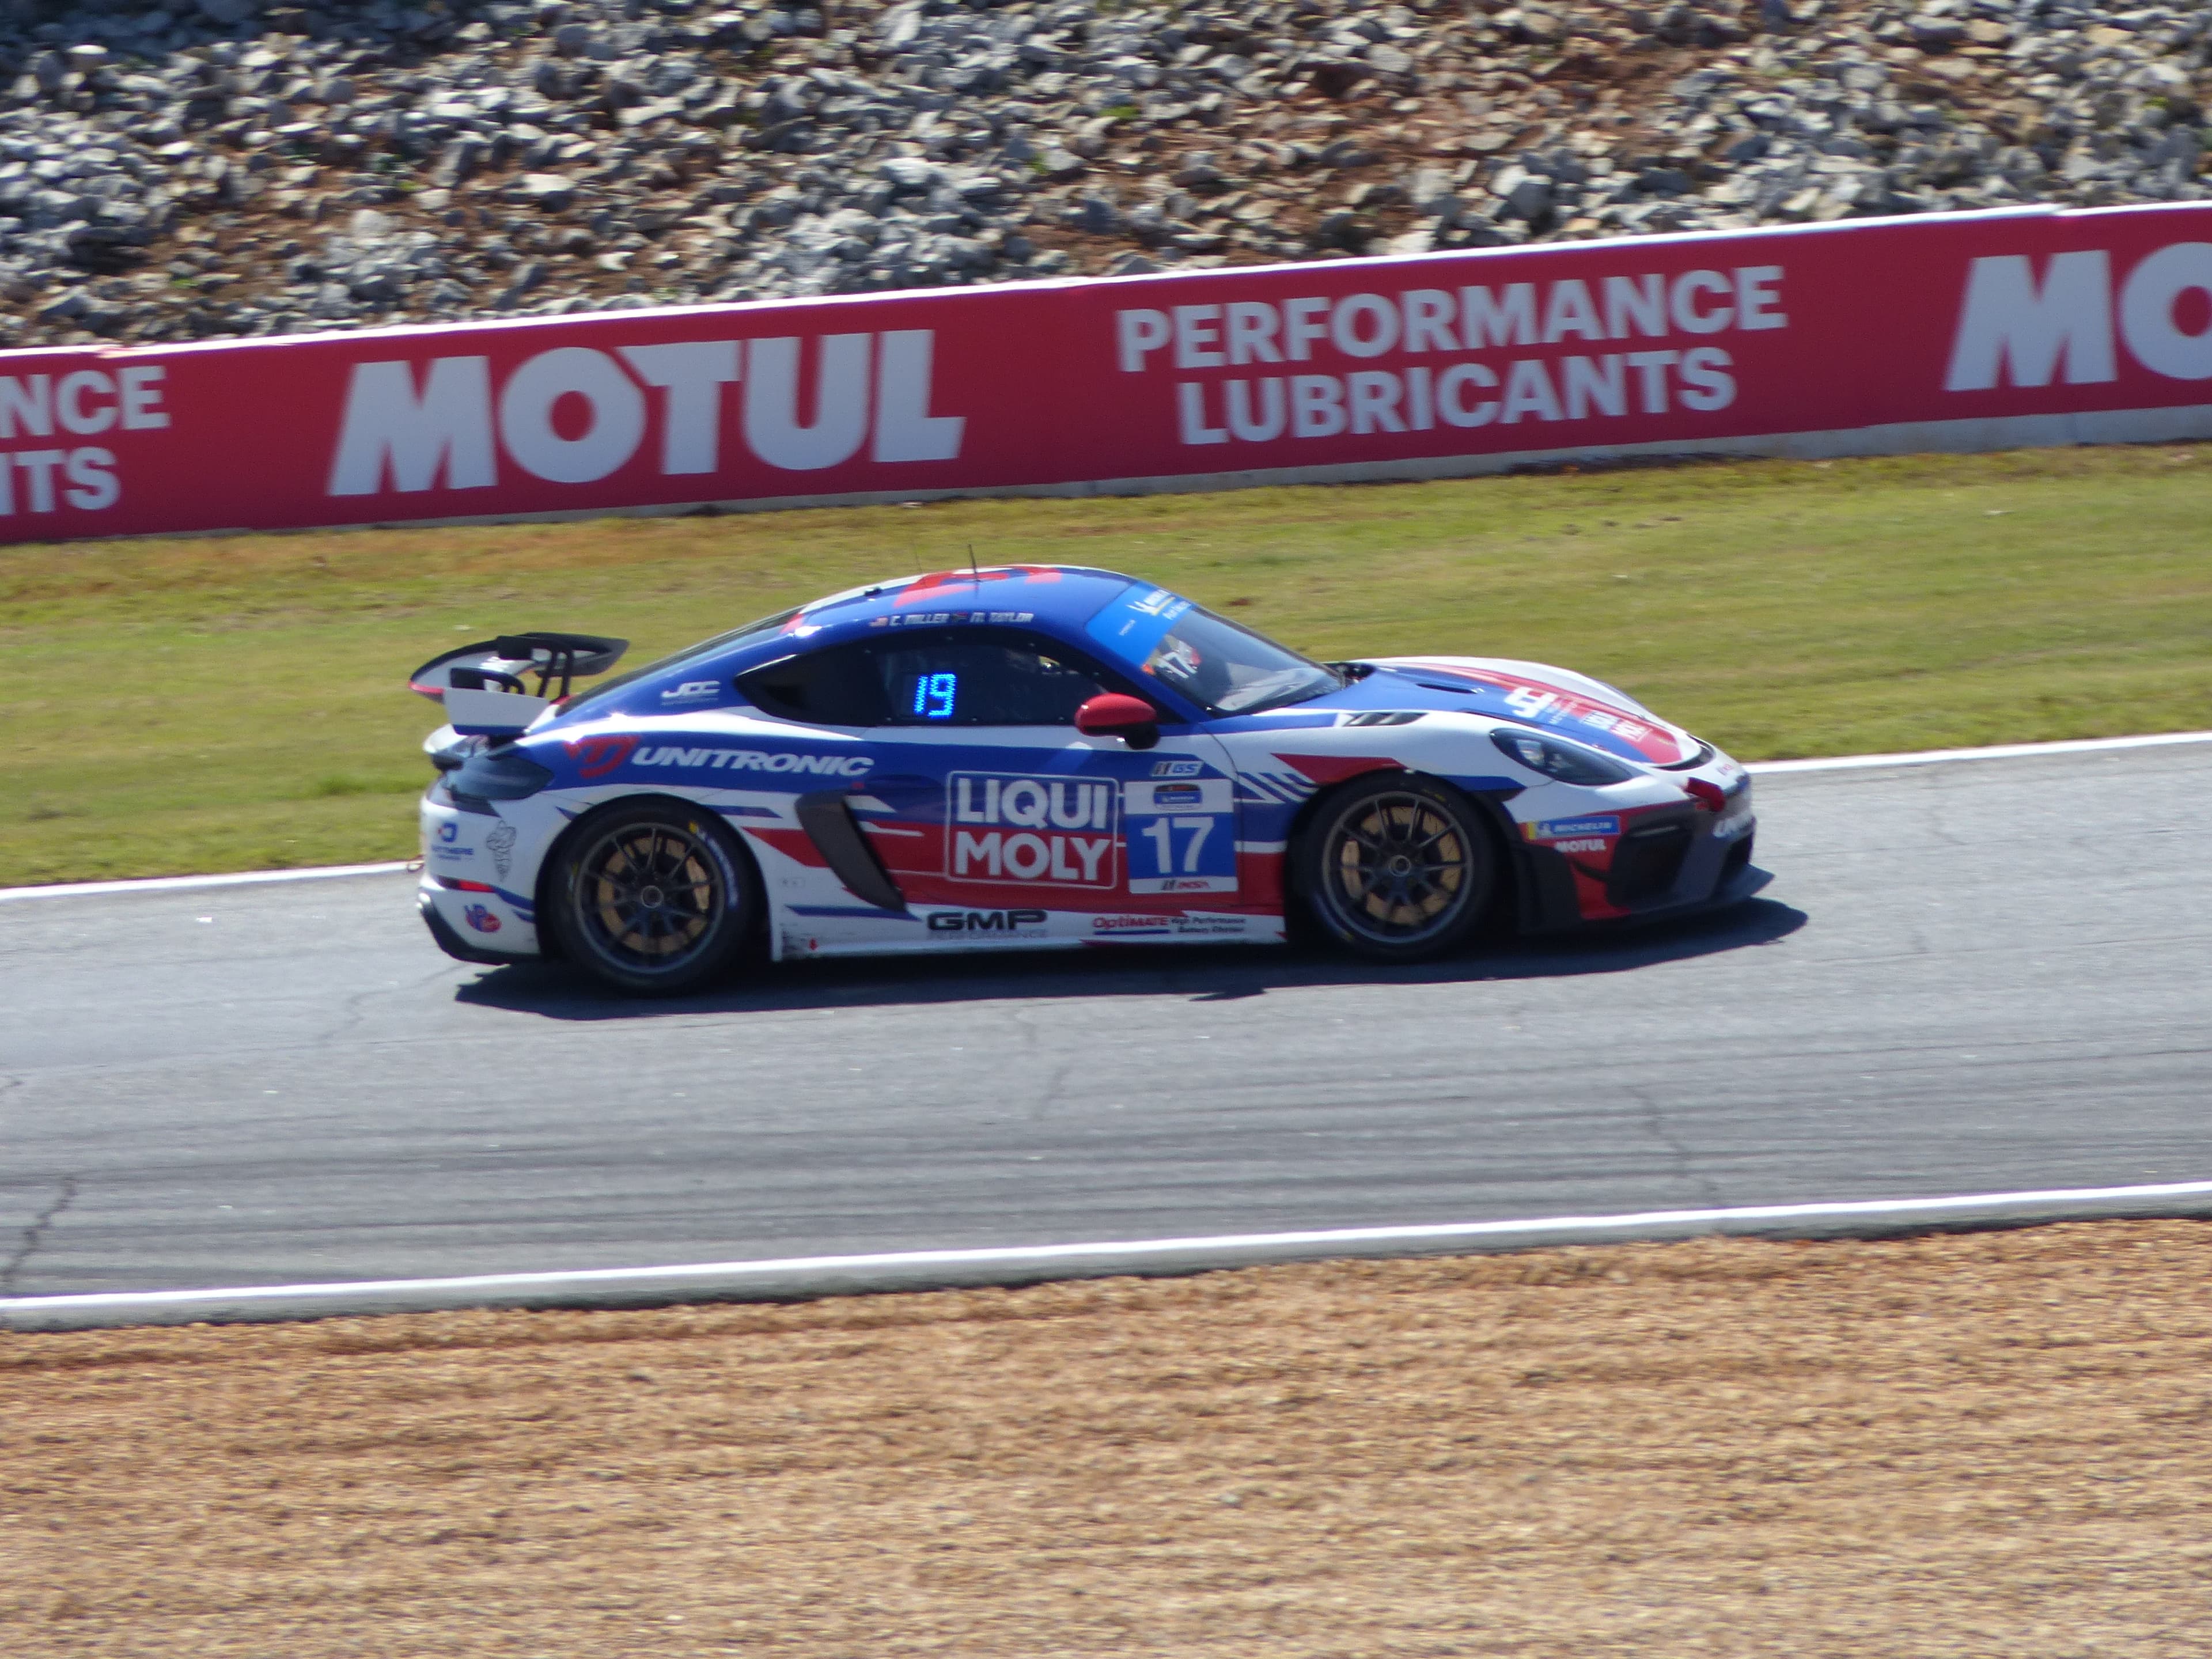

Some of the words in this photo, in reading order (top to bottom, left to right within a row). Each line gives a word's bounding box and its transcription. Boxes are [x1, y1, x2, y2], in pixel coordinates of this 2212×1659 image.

[1115, 264, 1789, 373] PERFORMANCE
[326, 328, 967, 497] MOTUL
[1176, 346, 1737, 446] LUBRICANTS
[914, 673, 956, 715] 19
[631, 747, 874, 777] UNITRONIC
[1172, 763, 1199, 773] GS
[957, 778, 1109, 830] LIQUI
[955, 831, 1112, 881] MOLY
[1141, 816, 1215, 874] 17
[1554, 839, 1607, 853] MOTUL
[926, 909, 1048, 931] GMP
